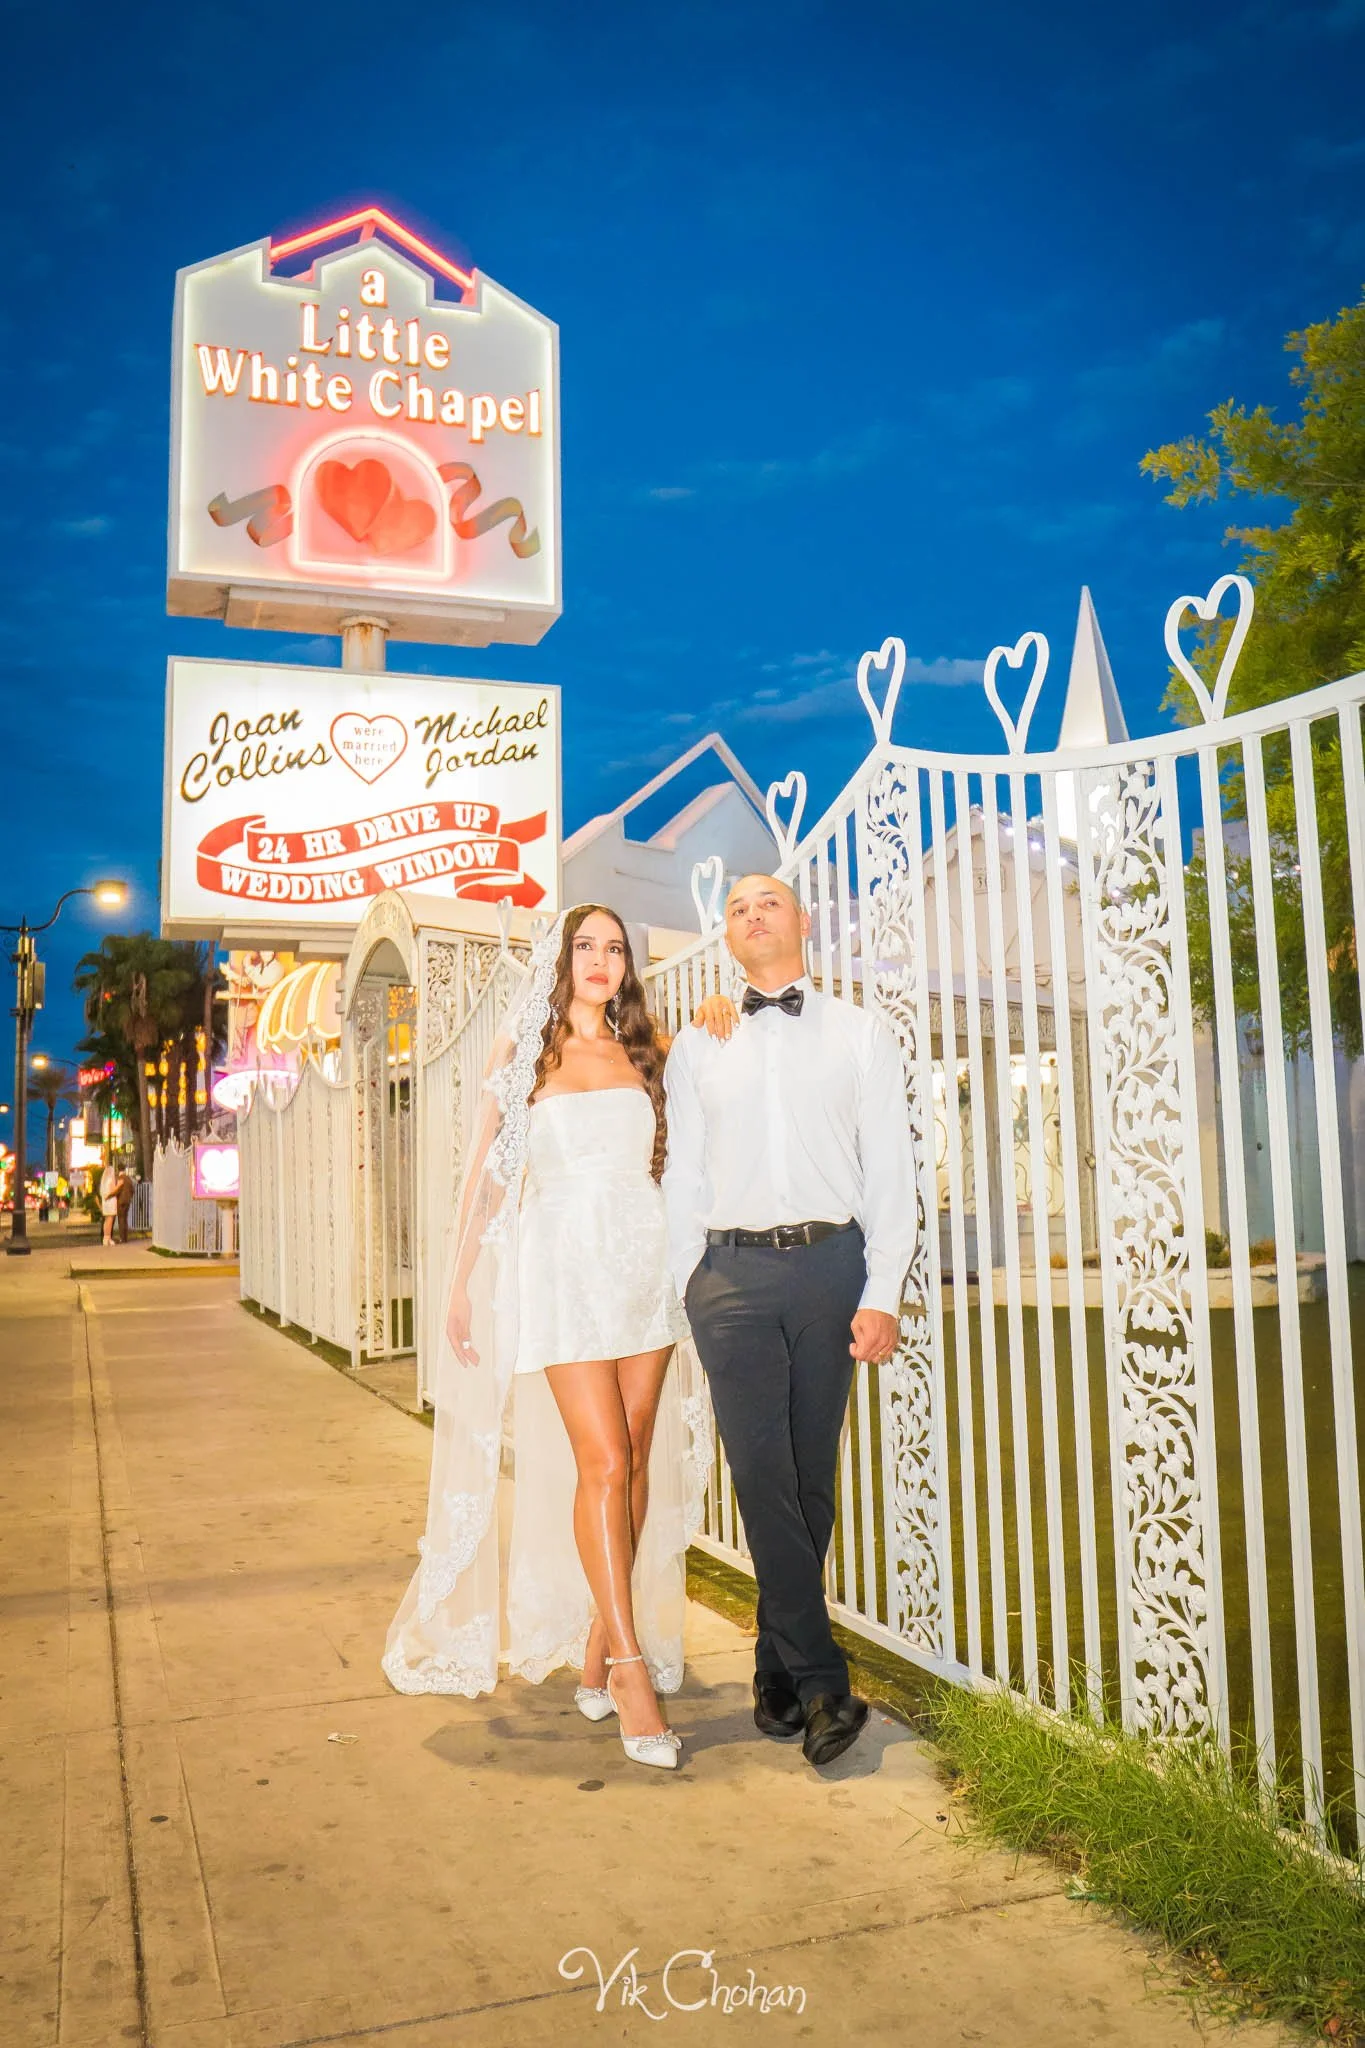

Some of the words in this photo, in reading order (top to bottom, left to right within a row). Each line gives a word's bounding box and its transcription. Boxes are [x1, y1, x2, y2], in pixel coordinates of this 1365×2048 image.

[359, 266, 388, 308] a
[300, 302, 451, 370] Little
[194, 342, 354, 412] White
[367, 368, 543, 445] Chapel
[208, 708, 304, 766] Joan
[342, 740, 397, 753] married
[354, 726, 384, 737] were
[413, 698, 550, 746] Michael
[180, 741, 332, 804] Collins
[354, 753, 383, 766] here
[424, 738, 541, 789] Jordan
[256, 836, 290, 864] 24
[302, 828, 348, 859] HR
[353, 806, 441, 849] DRIVE
[454, 801, 491, 829] UP
[219, 863, 366, 902] WEDDING
[372, 841, 501, 888] WINDOW
